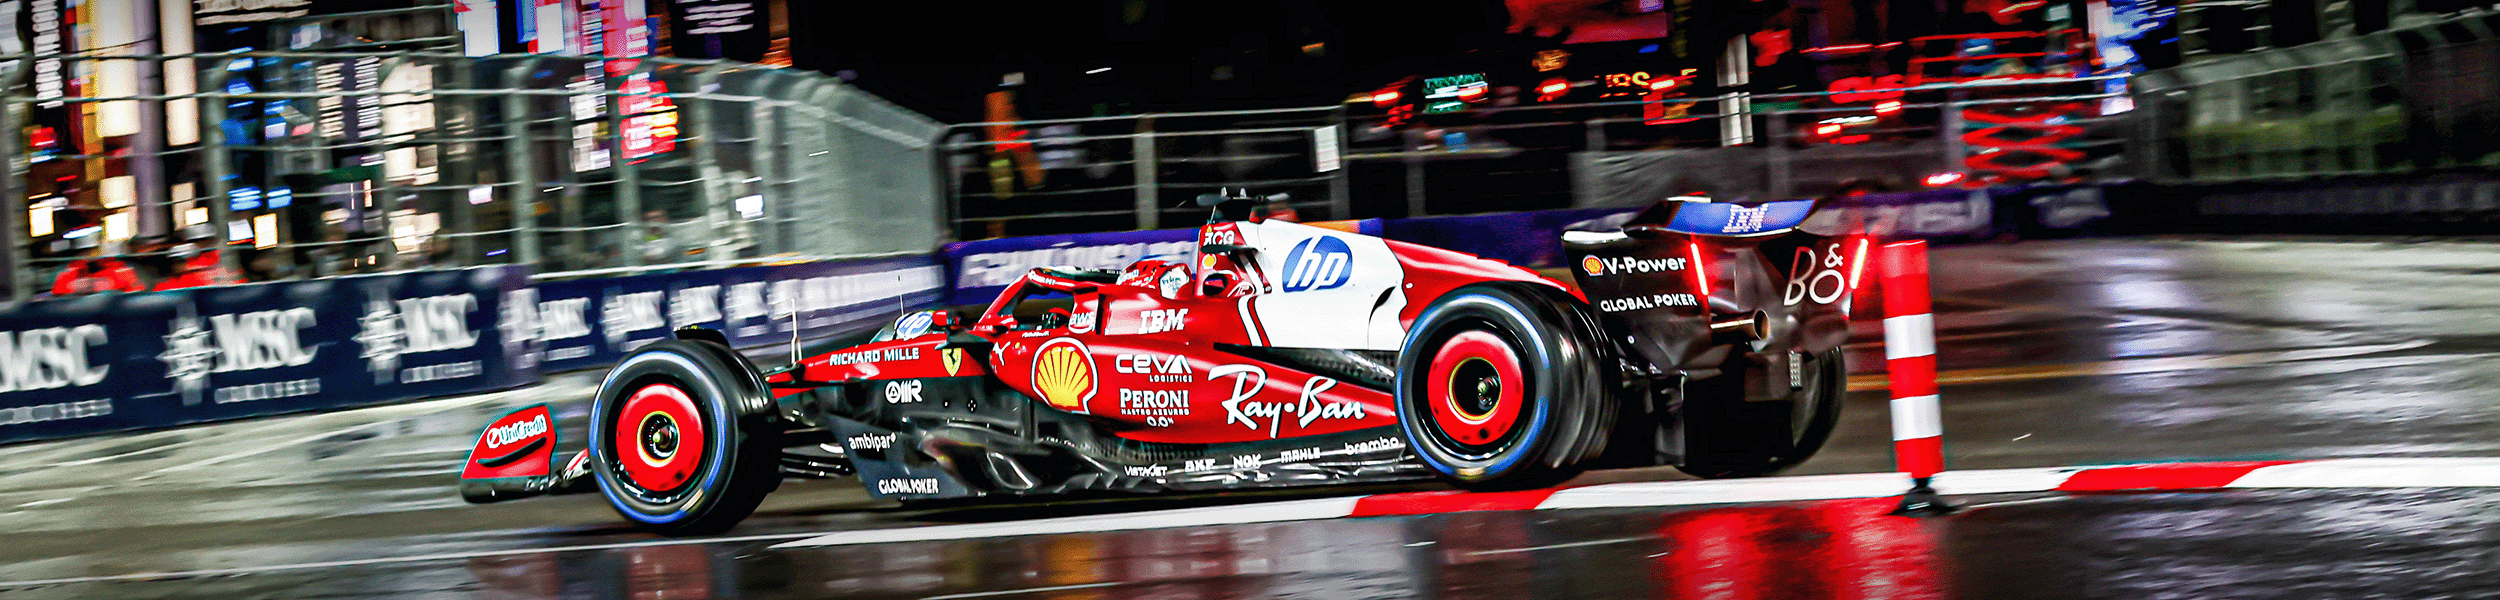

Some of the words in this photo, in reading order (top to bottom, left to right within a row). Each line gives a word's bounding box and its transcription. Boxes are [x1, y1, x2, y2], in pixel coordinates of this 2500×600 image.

[1283, 235, 1352, 292] hp
[1602, 256, 1687, 275] V-Power
[1600, 295, 1654, 312] GLOBAL
[1653, 293, 1698, 307] POKER
[1138, 308, 1189, 335] IBM
[829, 350, 881, 366] RICHARD
[884, 347, 920, 361] MILLE
[1119, 388, 1189, 408] PERONI
[499, 413, 548, 445] UniCredit
[848, 433, 891, 453] ambipar
[1345, 436, 1400, 456] brembo
[910, 477, 939, 494] POKER
